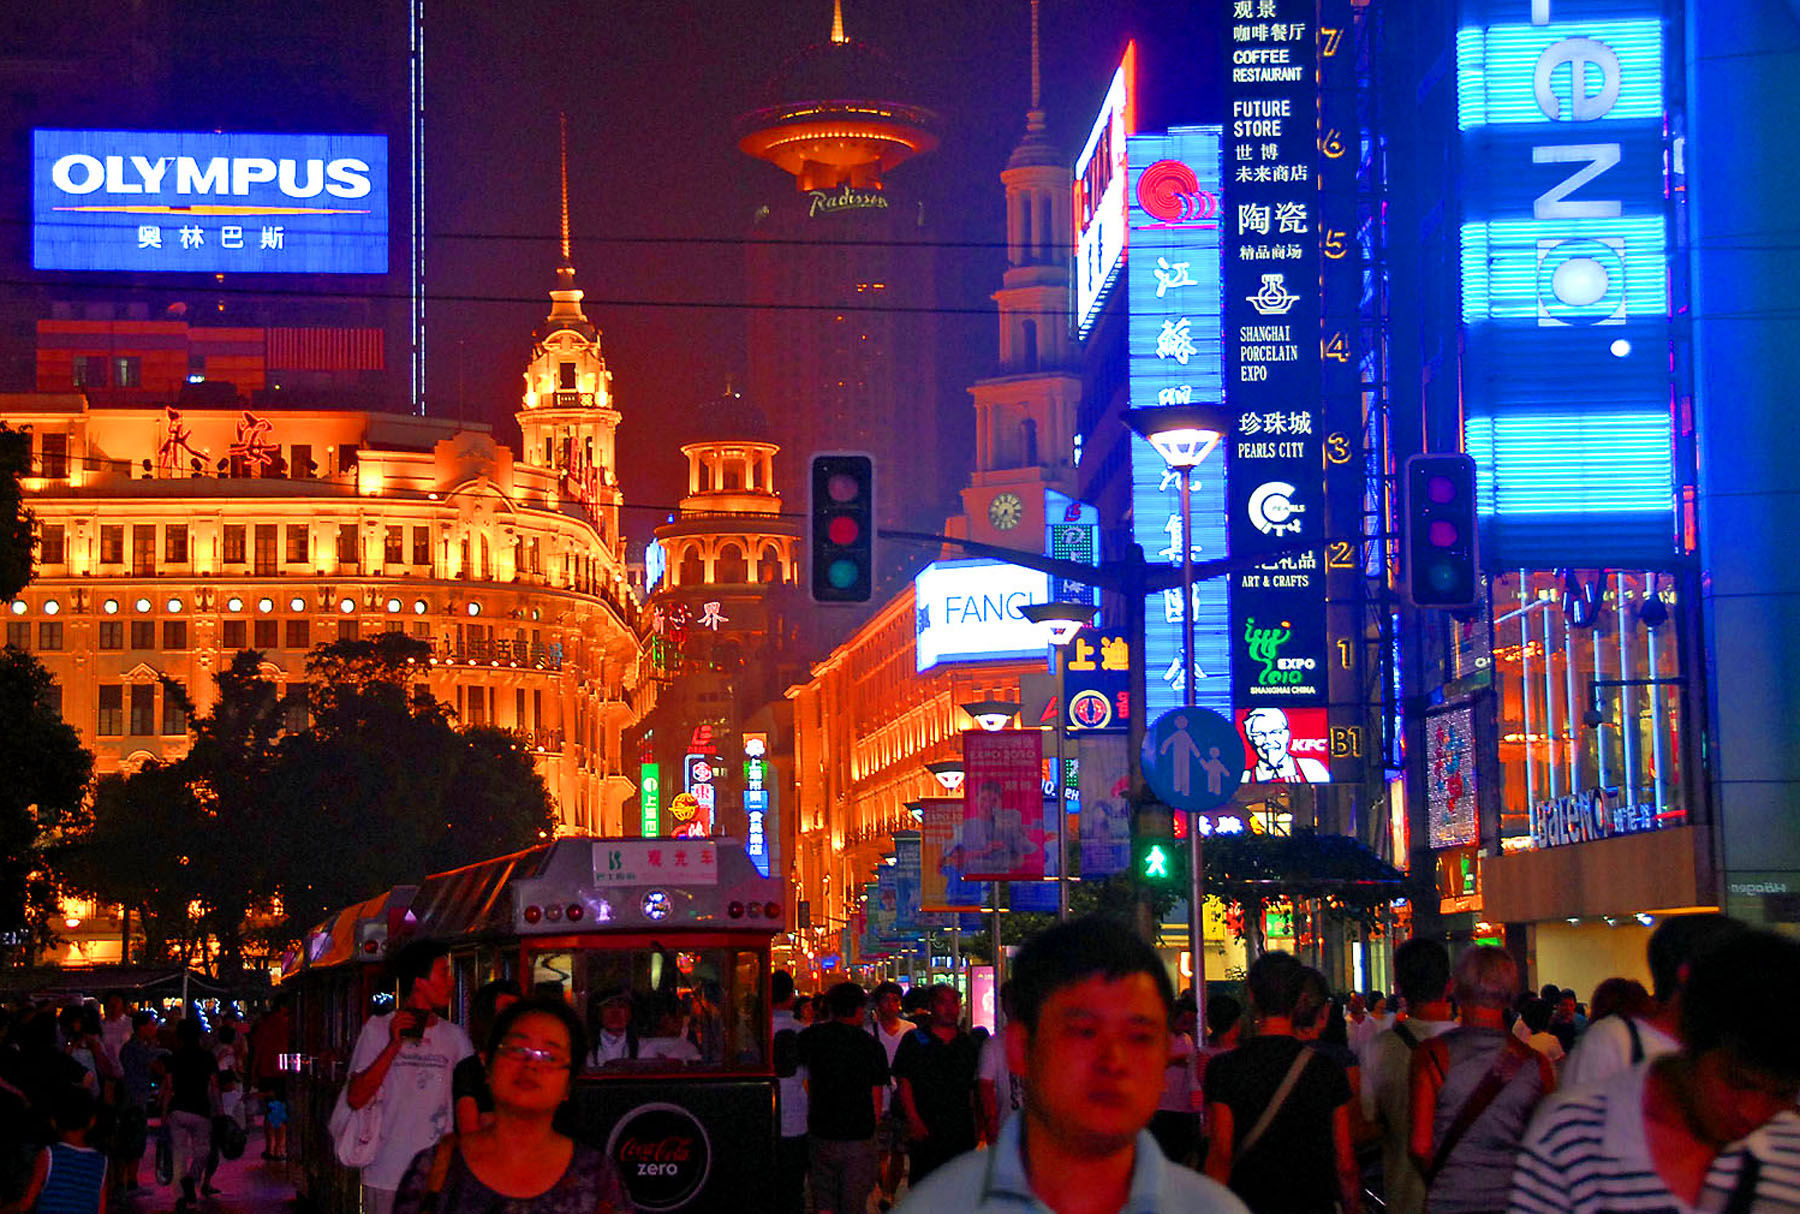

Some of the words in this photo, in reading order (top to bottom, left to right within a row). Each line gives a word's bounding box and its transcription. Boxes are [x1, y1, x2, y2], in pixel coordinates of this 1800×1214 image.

[1233, 23, 1305, 42] 咖啡餐厅
[1321, 27, 1344, 56] 7
[1233, 49, 1290, 64] COFFEE
[1233, 67, 1302, 82] RESTAURANT
[1233, 100, 1291, 117] FUTURE
[1233, 120, 1282, 137] STORE
[1235, 143, 1279, 161] 世博
[1323, 128, 1346, 158] 6
[1531, 0, 1627, 327] eNO
[52, 154, 371, 198] OLYMPUS
[1235, 164, 1308, 182] 未来商店
[809, 186, 888, 217] Radisson
[1238, 202, 1308, 235] 陶瓷
[138, 226, 285, 249] 奥林巴斯
[1324, 228, 1348, 259] 5
[1239, 244, 1302, 260] 精品商场
[1240, 326, 1290, 342] SHANGHAI
[1240, 345, 1298, 362] PORCELAIN
[1326, 331, 1351, 362] 4
[1241, 365, 1267, 381] EXPO
[1238, 411, 1312, 435] 珍珠城
[1238, 442, 1276, 458] PEARLS
[1279, 442, 1304, 458] CITY
[1327, 431, 1352, 464] 3
[1330, 541, 1355, 568] 2
[1242, 575, 1260, 587] ART
[1263, 575, 1270, 587] &
[1273, 575, 1309, 587] CRAFTS
[1337, 639, 1354, 669] 1
[1278, 659, 1316, 670] EXPO
[1251, 686, 1290, 694] SHANGHAI
[1291, 686, 1316, 694] CHINA
[1291, 739, 1328, 751] KFC
[1330, 727, 1361, 758] B1
[637, 1163, 678, 1176] zero
